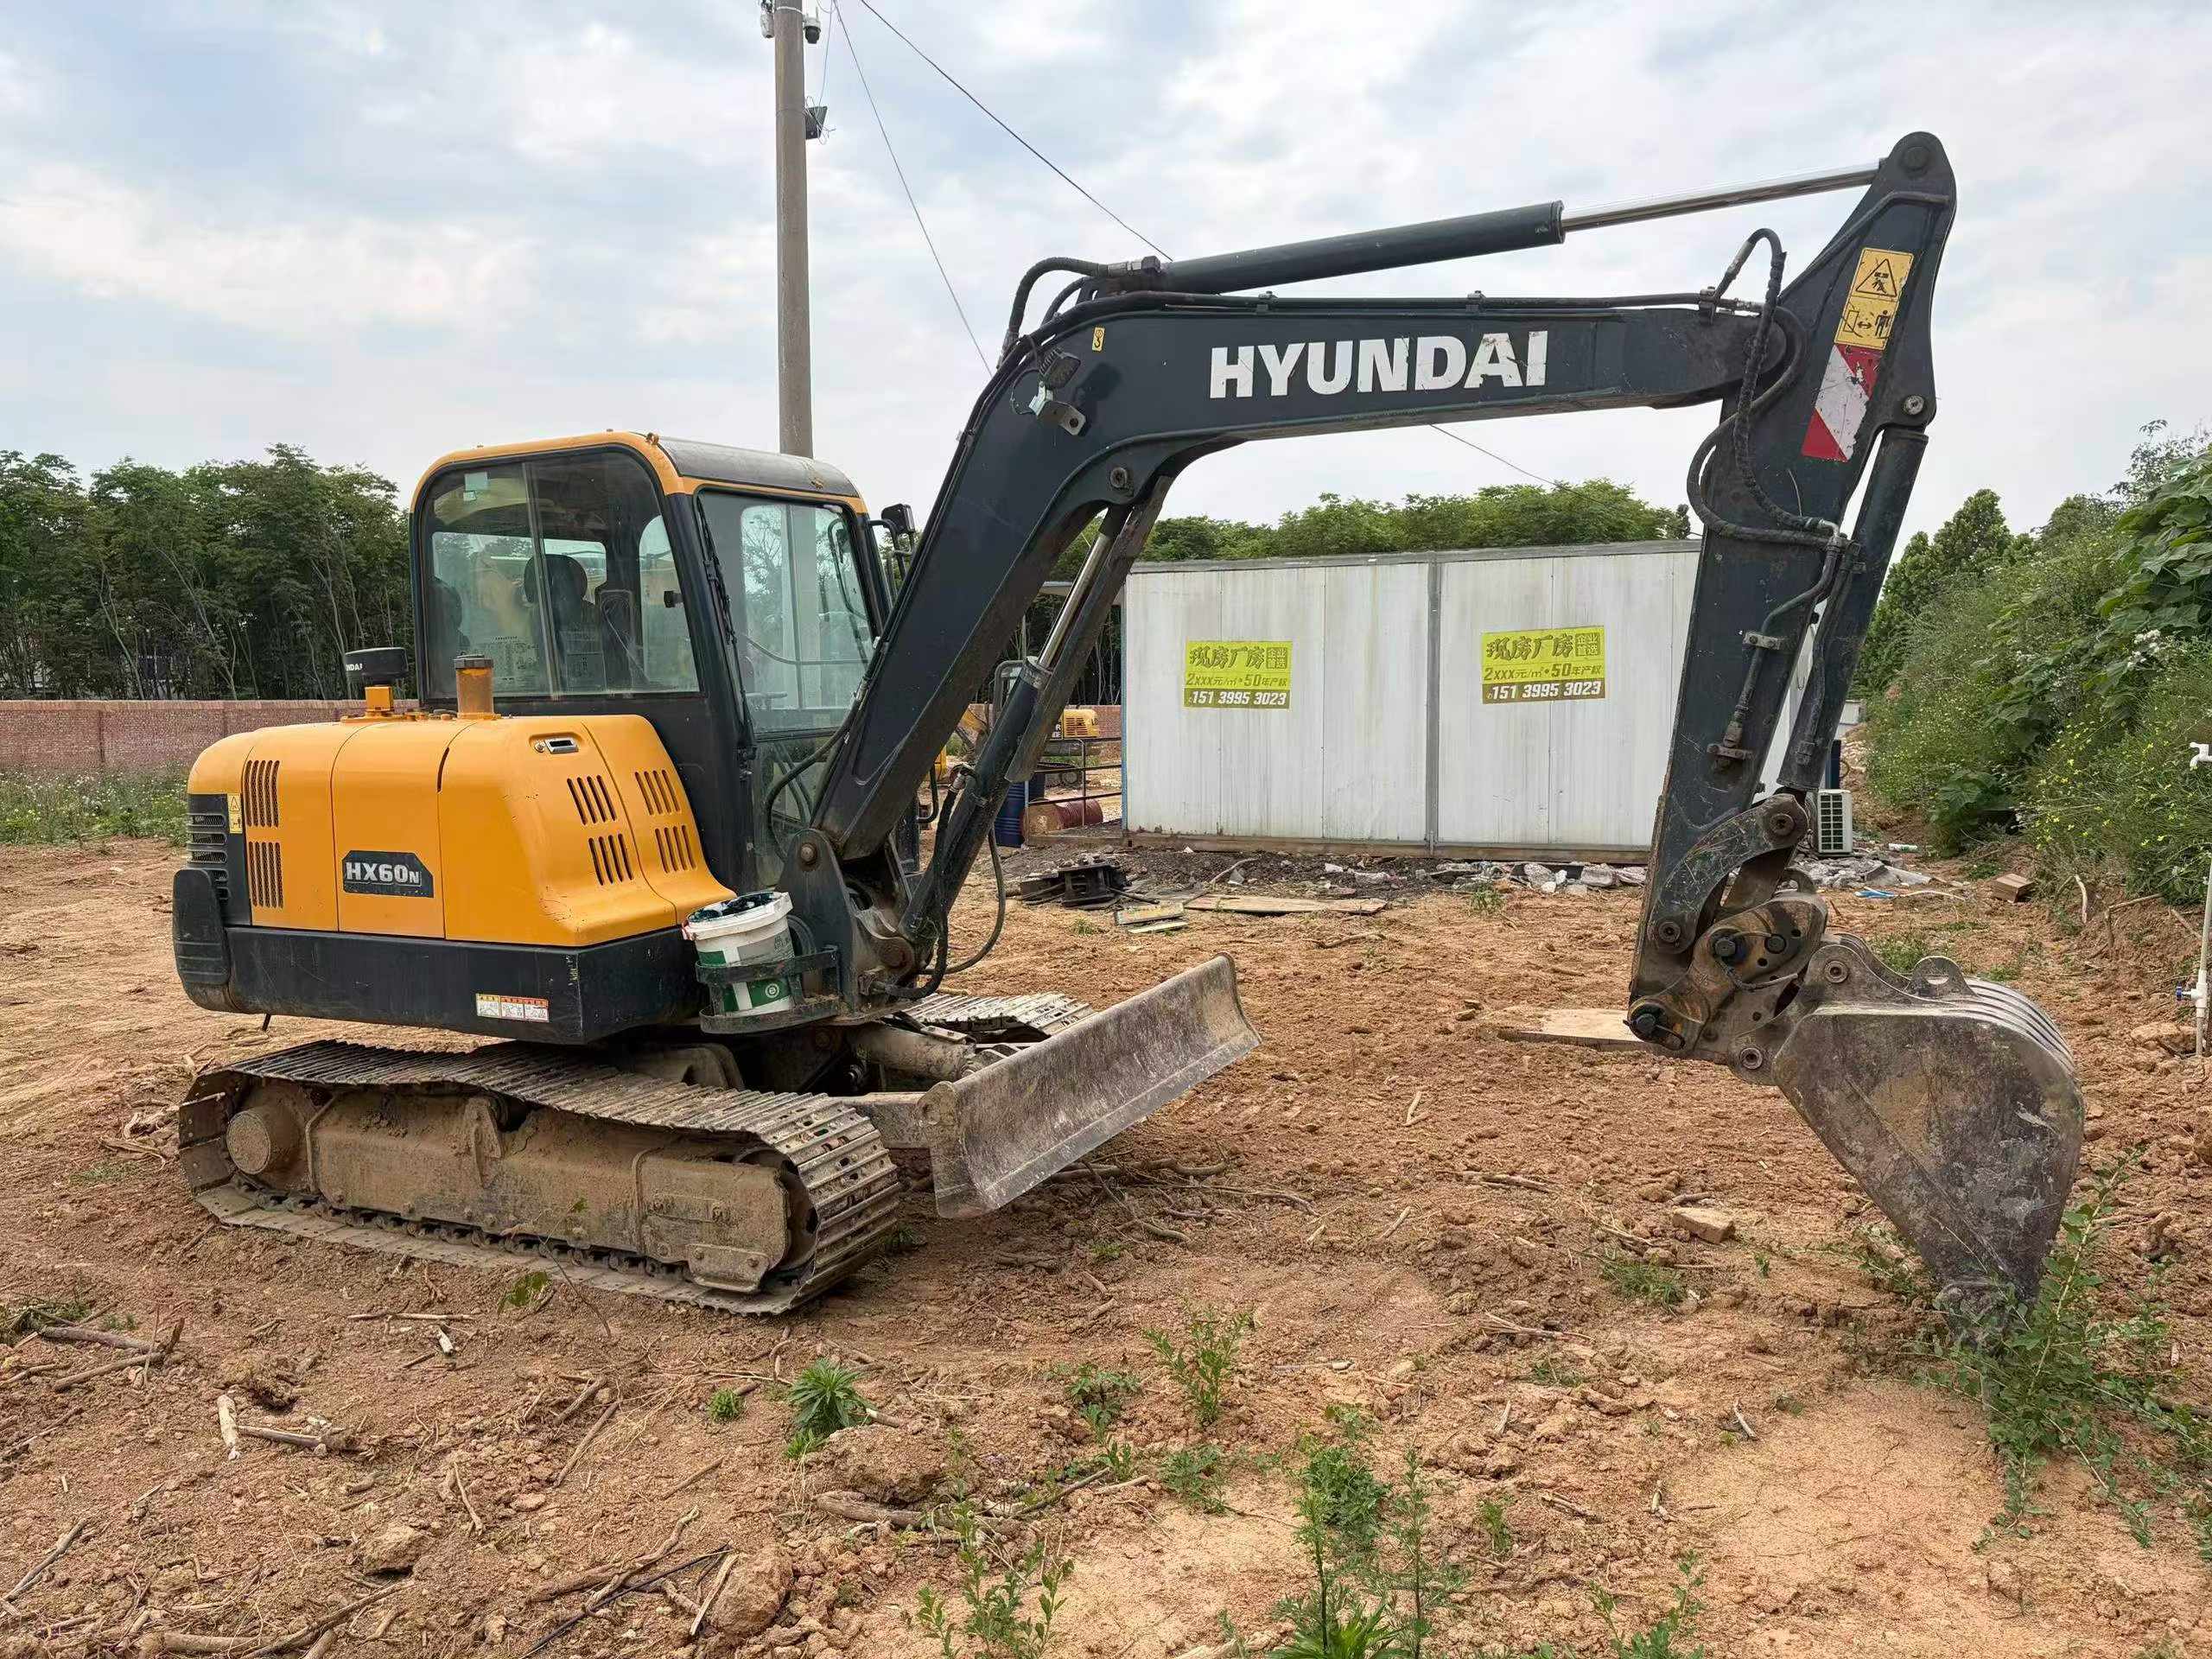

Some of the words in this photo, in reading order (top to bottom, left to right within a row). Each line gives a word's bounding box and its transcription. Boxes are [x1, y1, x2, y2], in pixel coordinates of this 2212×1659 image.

[1210, 330, 1548, 399] HYUNDAI
[1192, 691, 1214, 704] 151
[1218, 691, 1250, 705] 3995
[1254, 692, 1287, 705] 3023
[1492, 685, 1517, 699] 151
[1522, 683, 1560, 698] 3995
[1563, 681, 1602, 696] 3023
[346, 861, 420, 884] HX60N
